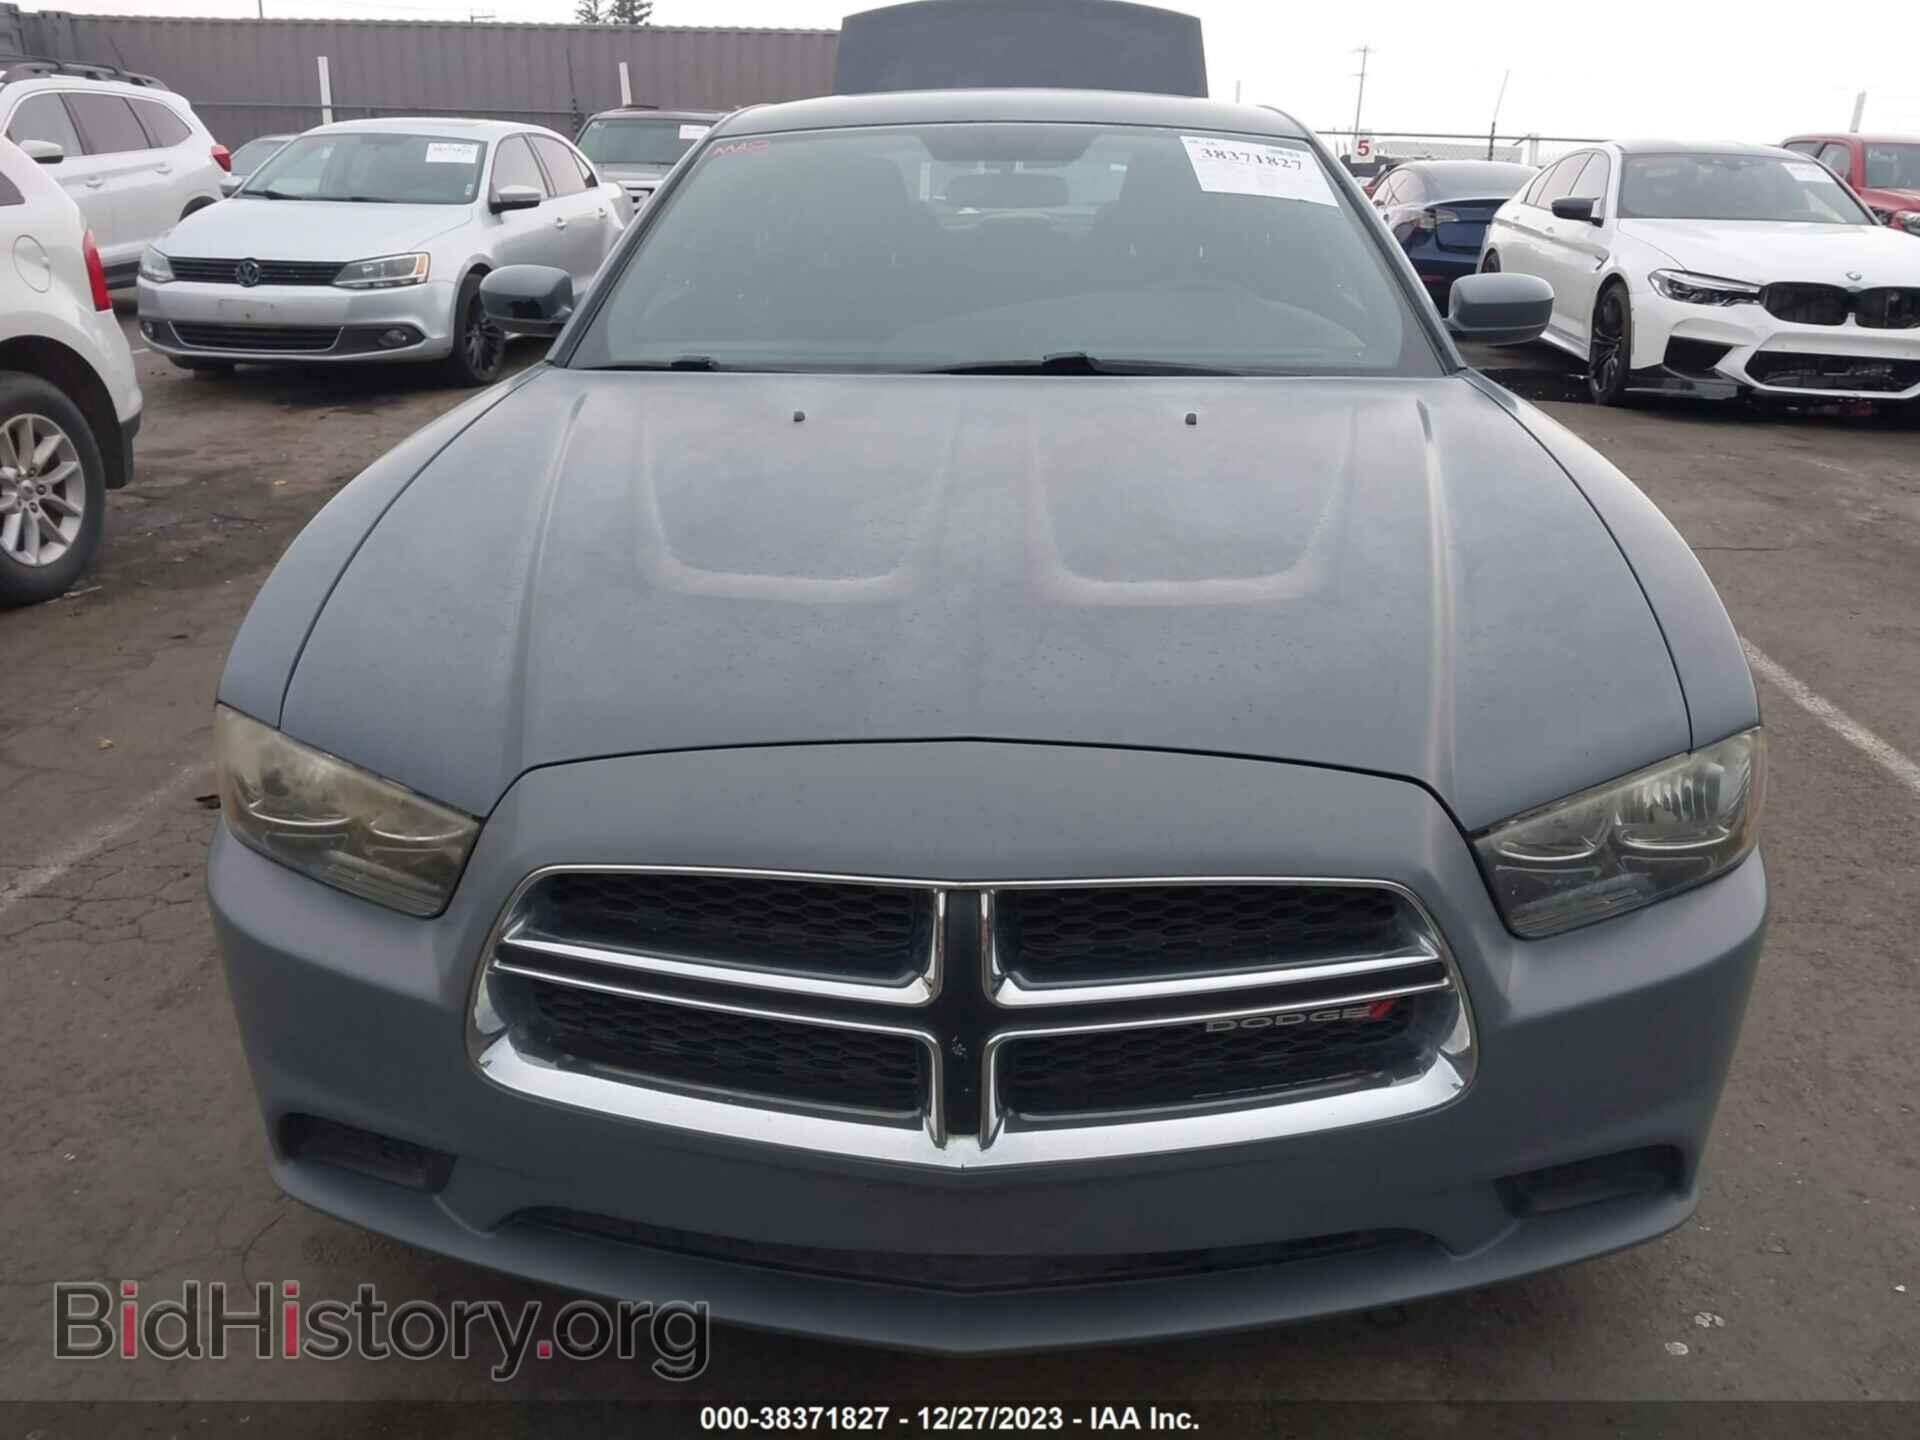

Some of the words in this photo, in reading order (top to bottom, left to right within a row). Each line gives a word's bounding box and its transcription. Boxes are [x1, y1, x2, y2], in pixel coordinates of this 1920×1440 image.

[1201, 147, 1302, 170] 38371827
[1357, 140, 1370, 157] 5
[1205, 1006, 1371, 1032] DODGE
